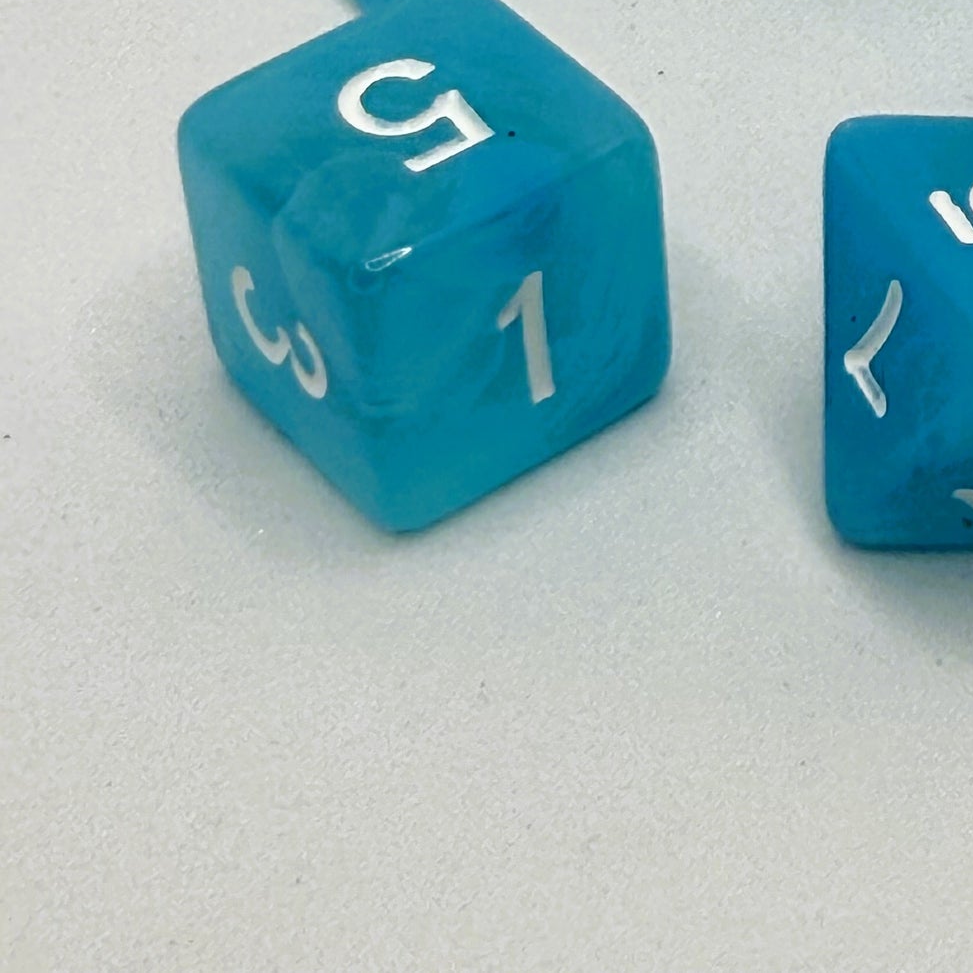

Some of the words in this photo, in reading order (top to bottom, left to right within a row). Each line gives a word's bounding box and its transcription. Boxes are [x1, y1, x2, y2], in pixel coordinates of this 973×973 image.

[337, 57, 496, 173] 5
[231, 265, 328, 400] 3
[496, 270, 556, 406] 1
[844, 279, 903, 418] 7
